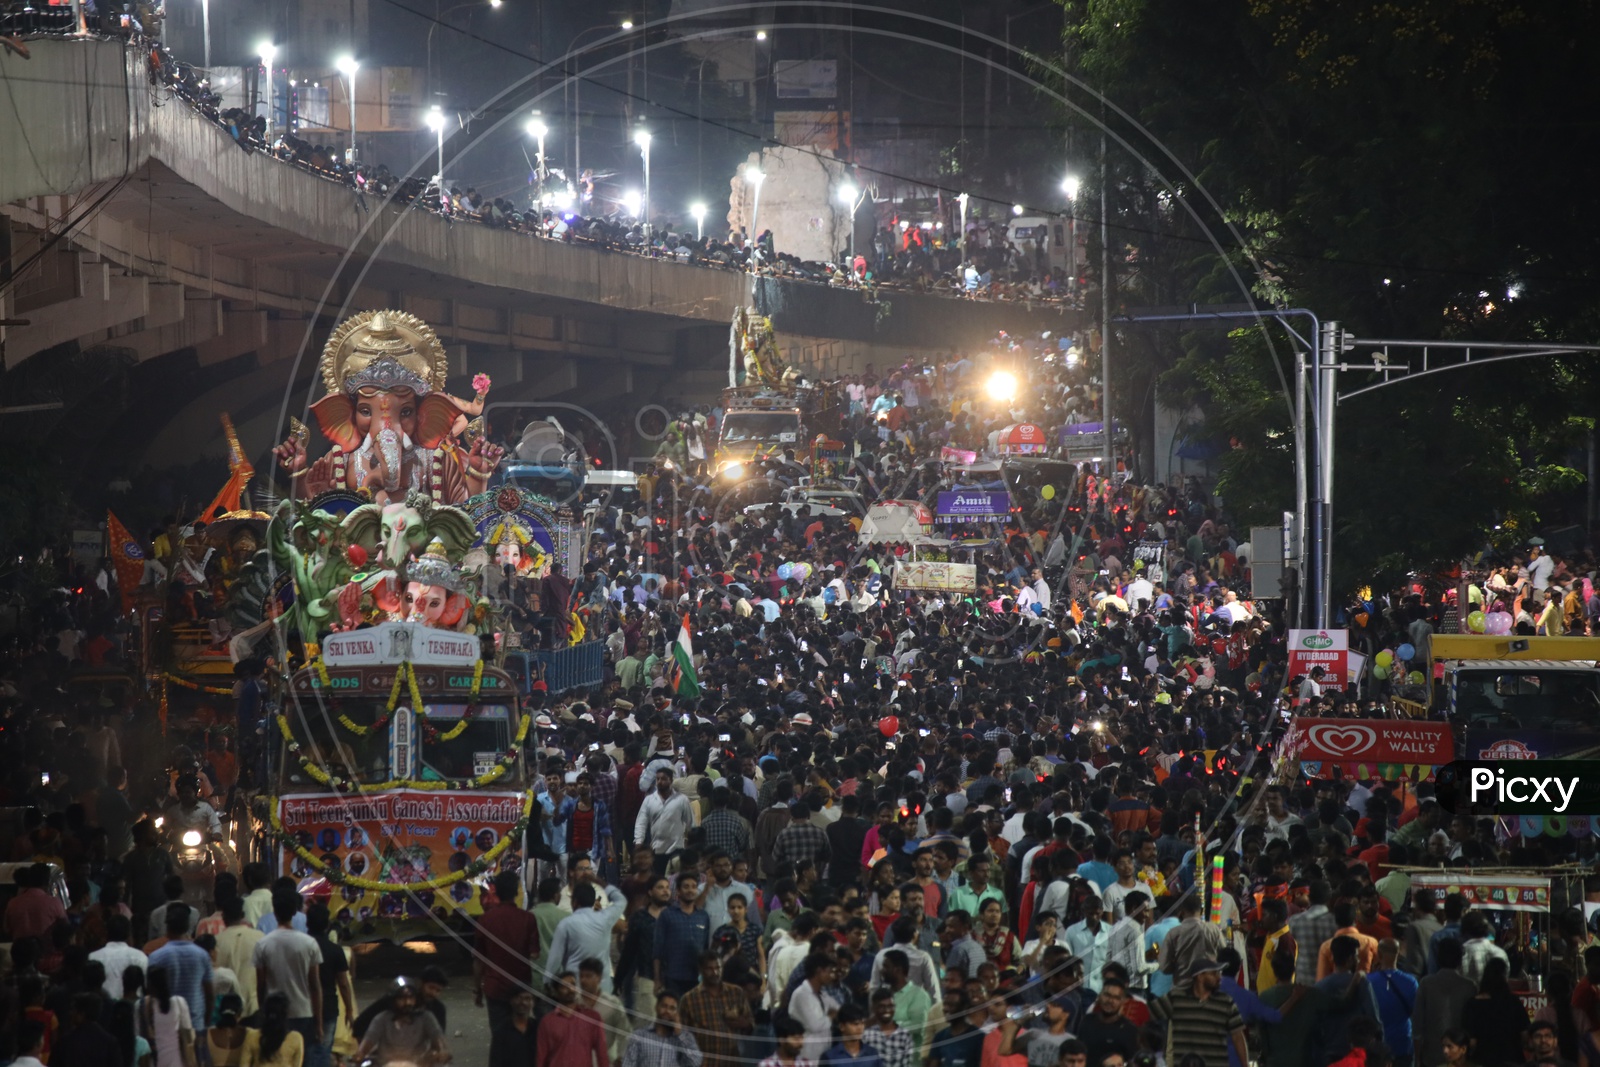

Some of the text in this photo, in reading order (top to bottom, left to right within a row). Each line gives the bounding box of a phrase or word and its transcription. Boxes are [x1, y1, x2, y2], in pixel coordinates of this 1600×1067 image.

[953, 495, 992, 507] Amul
[1305, 637, 1331, 646] GHMC
[329, 640, 375, 656] SRI VENKA
[1297, 651, 1339, 661] HYDERABAD
[311, 677, 359, 689] GODS
[449, 676, 497, 689] CARER
[1383, 729, 1442, 741] KWALITY
[1389, 741, 1436, 753] WALL'S
[1484, 752, 1532, 760] JERSEY
[285, 802, 307, 826] Sri
[308, 798, 389, 827] Teengundu
[392, 796, 443, 823] Ganesh
[405, 823, 439, 837] Year
[1435, 889, 1534, 901] 20 30 40 50
